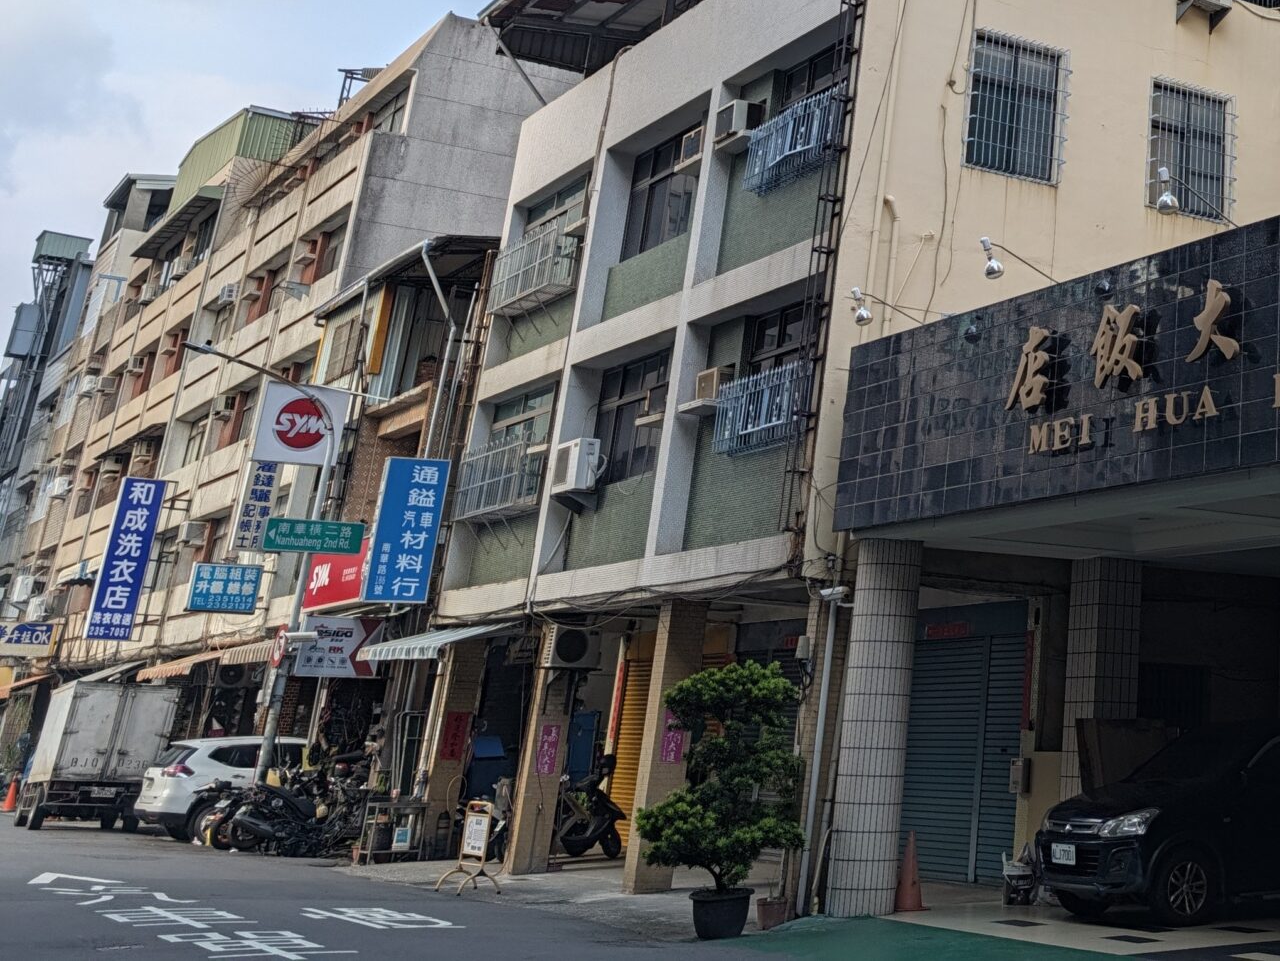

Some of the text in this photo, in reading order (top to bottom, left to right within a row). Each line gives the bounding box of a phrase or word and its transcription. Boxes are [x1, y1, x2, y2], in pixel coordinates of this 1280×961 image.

[274, 412, 330, 438] SYM
[1028, 413, 1095, 455] MEI
[1133, 384, 1220, 432] HUA
[101, 481, 156, 610] 和成洗衣店
[275, 535, 351, 550] Nanhuaheng 2nd Rd.
[88, 626, 130, 637] 235-7051
